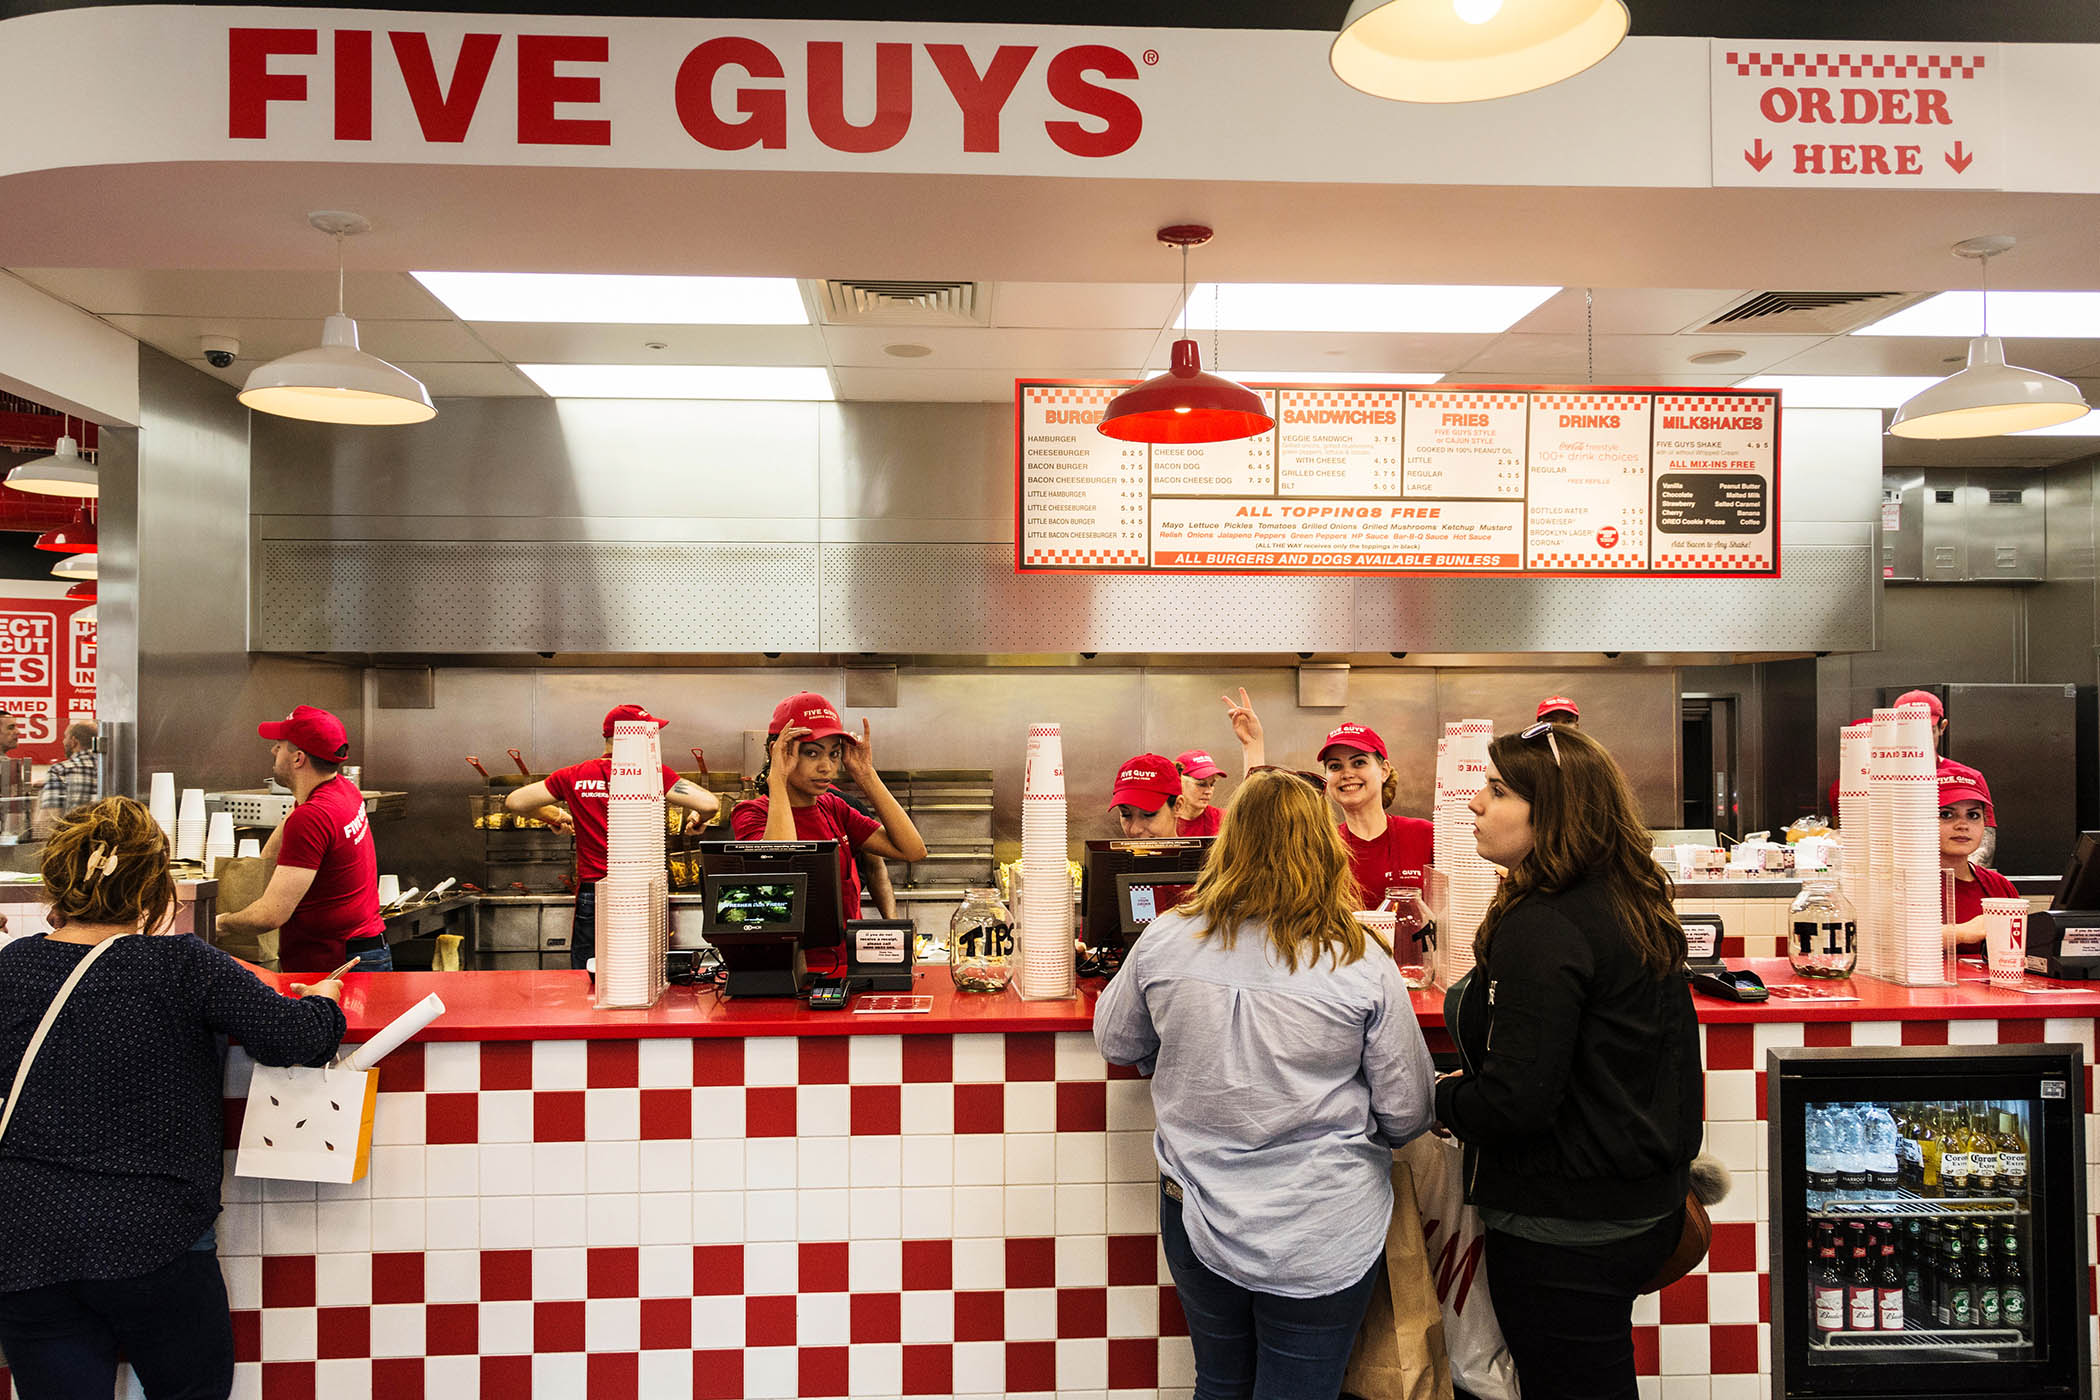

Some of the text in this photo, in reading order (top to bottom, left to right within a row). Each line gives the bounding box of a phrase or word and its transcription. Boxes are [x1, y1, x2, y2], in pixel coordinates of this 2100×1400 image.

[229, 28, 611, 146] FIVE
[1760, 86, 1953, 125] ORDER
[1792, 143, 1924, 175] HERE
[1045, 409, 1104, 424] BURGE
[1283, 409, 1397, 424] SANDWICHES
[1441, 412, 1489, 427] FRIES
[1559, 414, 1621, 429] DRINKS
[1663, 415, 1763, 430] MILKSHAKES
[1028, 435, 1077, 443] HAMBURGER
[1028, 449, 1090, 457] CHEESEBURGER
[1531, 466, 1567, 474] REGULAR
[1669, 460, 1756, 468] ALL MIX-INS FREE
[1407, 470, 1443, 478] REGULAR
[1235, 506, 1441, 518] ALL TOPPINGS FREE
[1301, 522, 1328, 530] Grilled
[1329, 522, 1357, 530] Onions
[1174, 554, 1501, 566] ALL BURGERS AND DOGS AVAILABLE BUNLESS
[0, 637, 49, 653] CUT
[804, 708, 822, 717] FIVE
[619, 768, 642, 776] FIVE
[574, 780, 606, 790] FIVE
[959, 922, 1014, 957] TIPS
[1793, 921, 1857, 955] TIP
